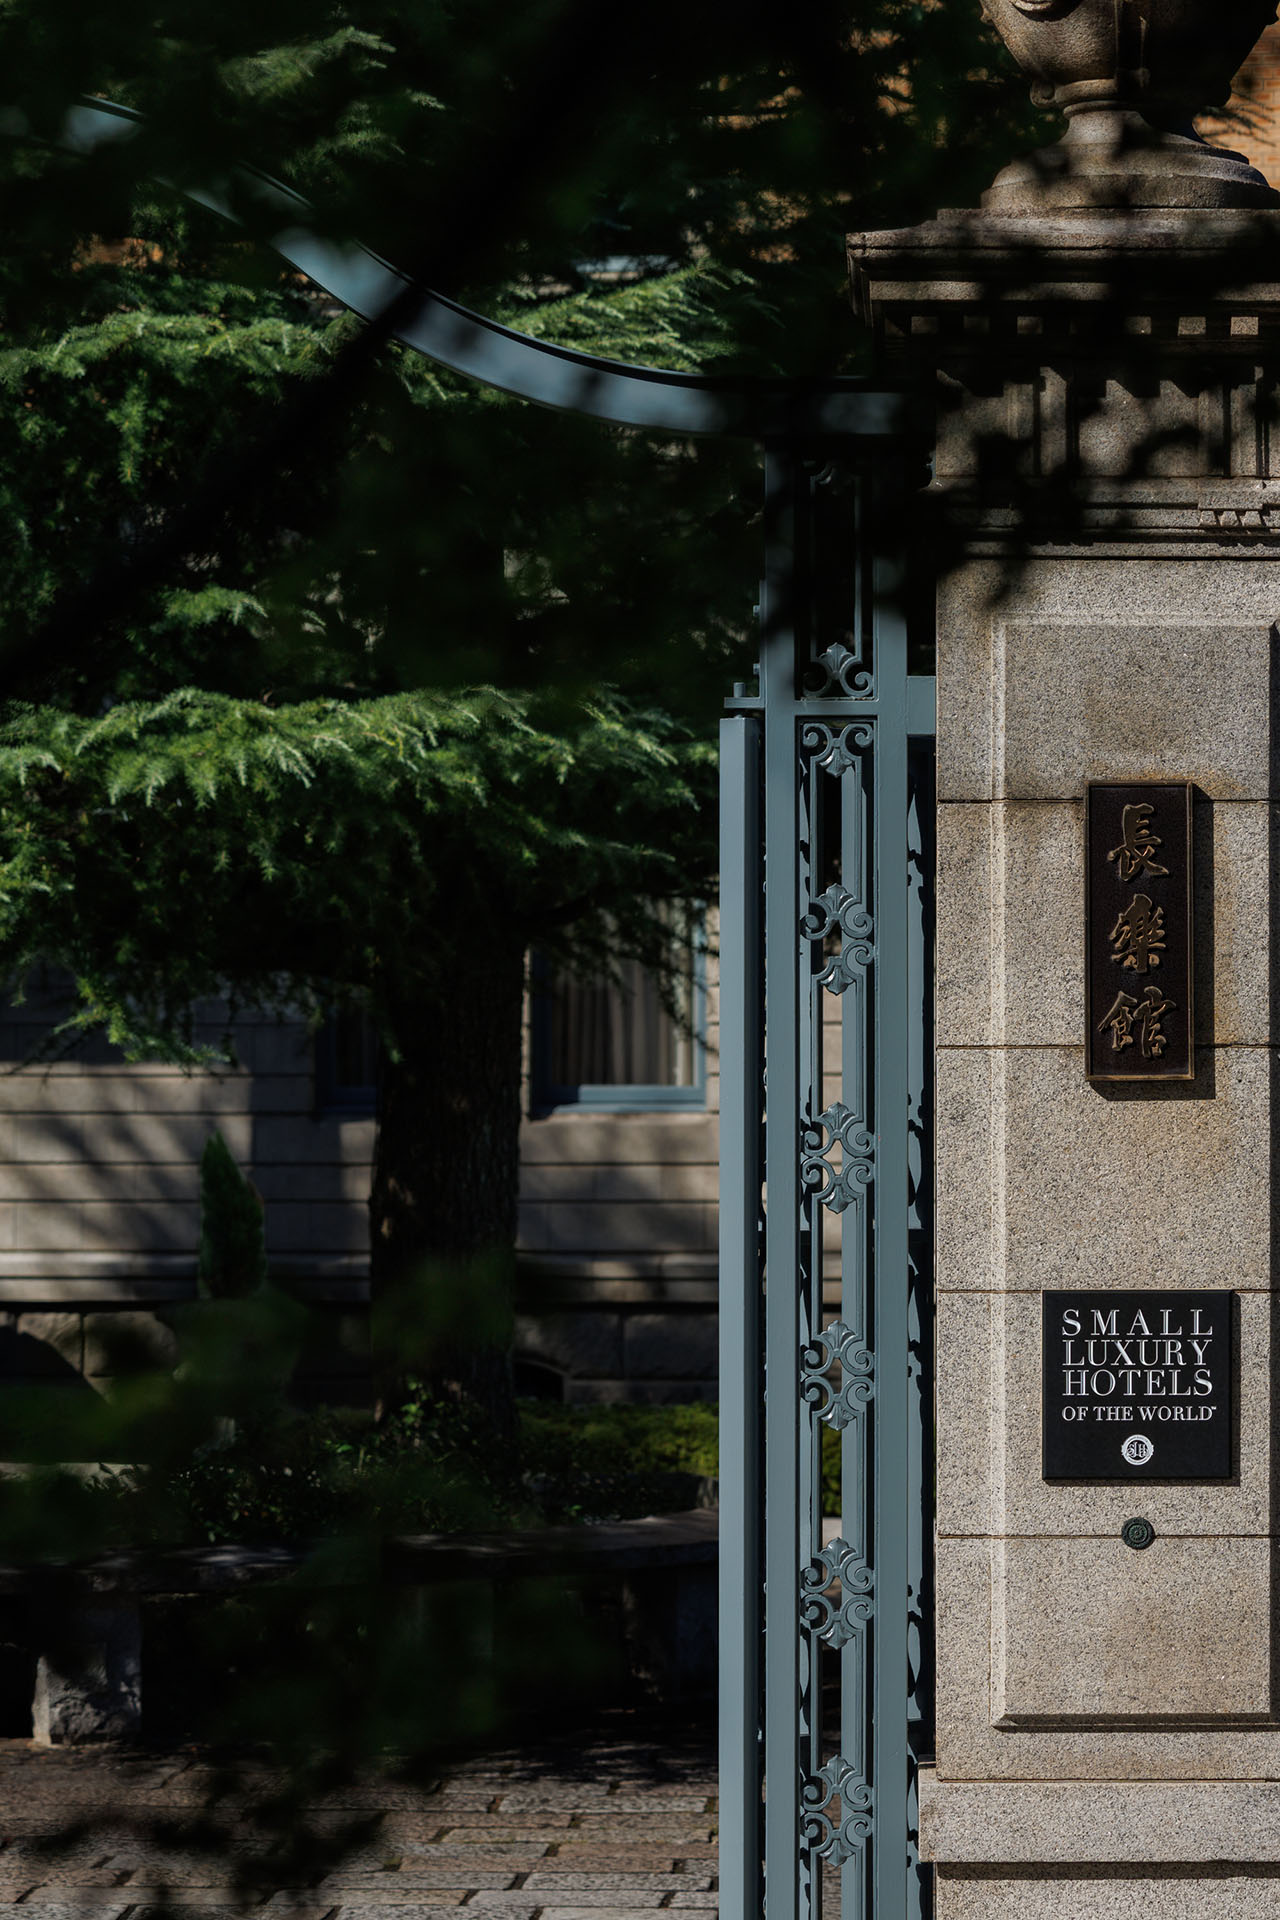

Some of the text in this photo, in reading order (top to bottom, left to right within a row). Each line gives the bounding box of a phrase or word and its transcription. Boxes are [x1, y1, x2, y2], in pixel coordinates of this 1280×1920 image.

[1097, 802, 1177, 1058] 長樂館
[1062, 1308, 1213, 1336] SMALL
[1062, 1339, 1213, 1366] LUXURY
[1062, 1369, 1213, 1396] HOTELS
[1062, 1406, 1088, 1421] OF
[1093, 1406, 1134, 1421] THE
